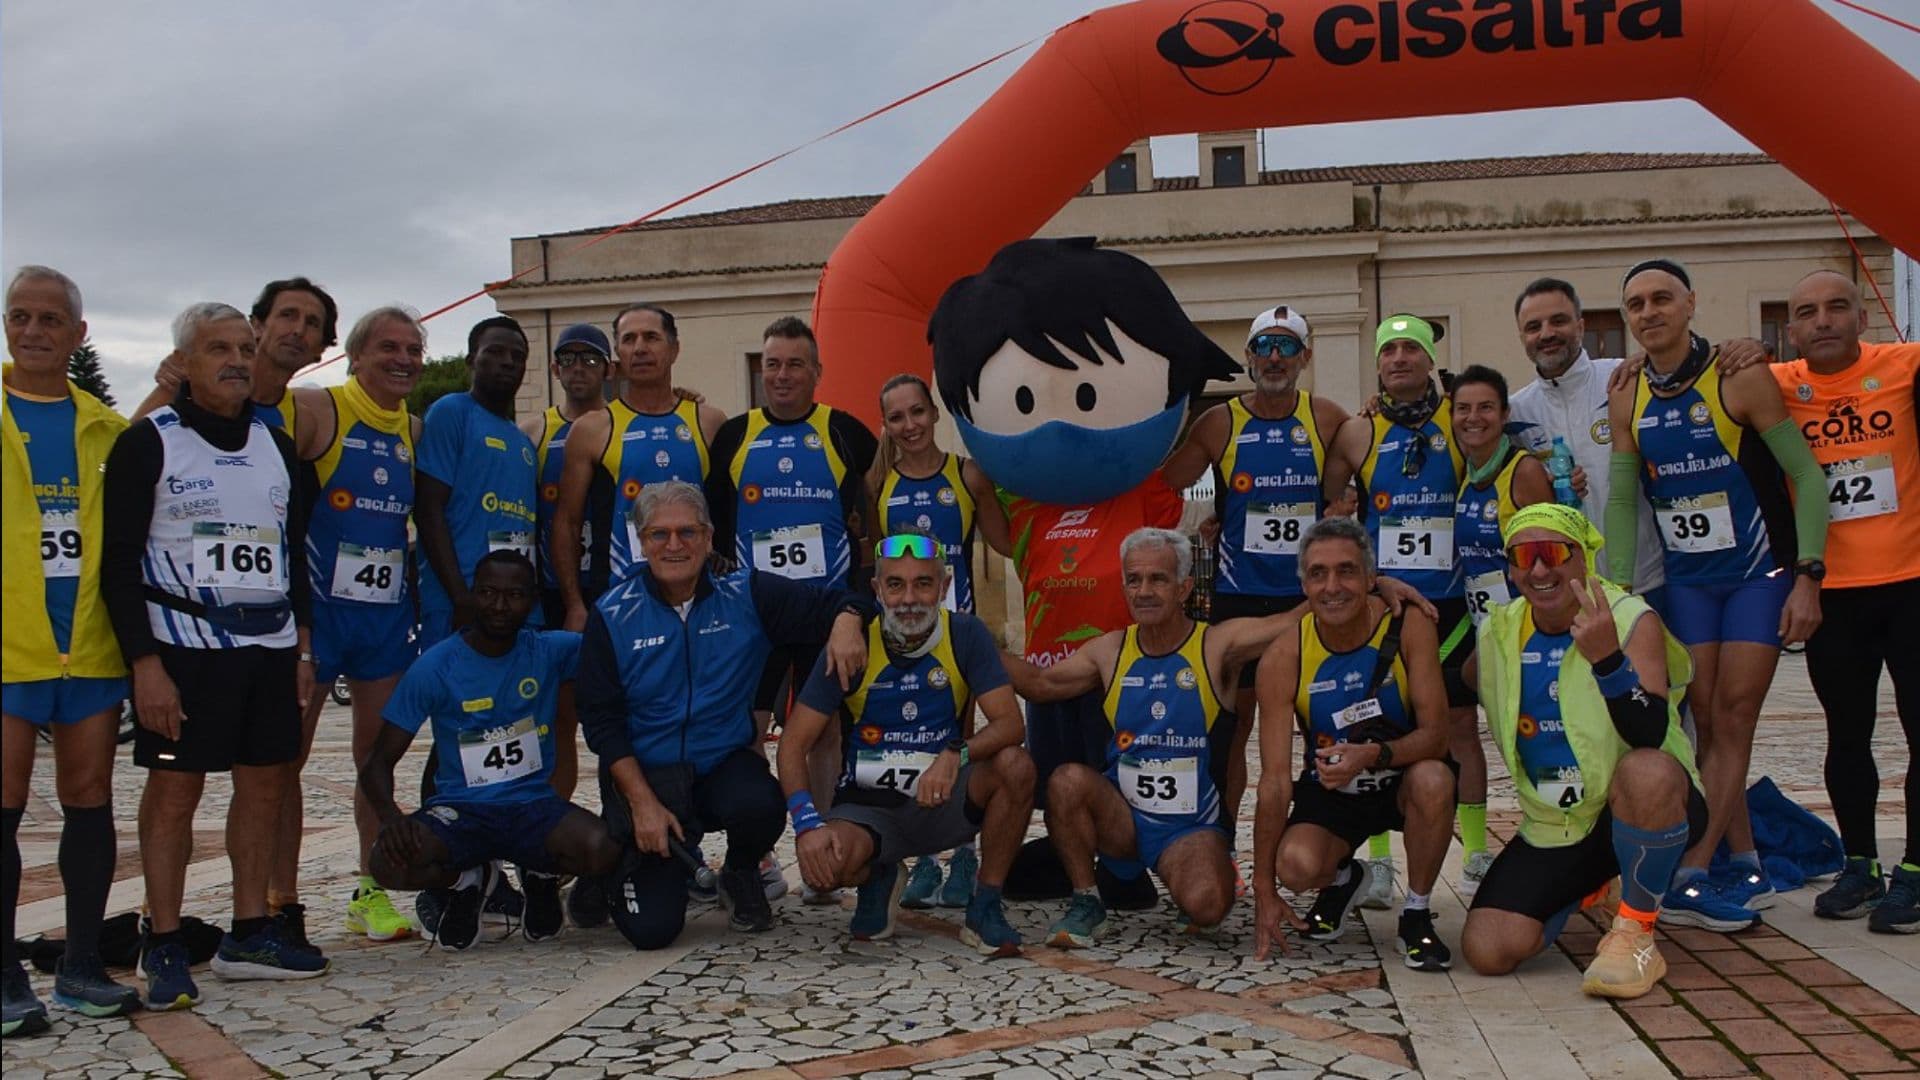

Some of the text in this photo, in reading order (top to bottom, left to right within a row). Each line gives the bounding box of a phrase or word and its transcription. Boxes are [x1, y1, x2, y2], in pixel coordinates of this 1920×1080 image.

[1313, 0, 1684, 66] cisalfa
[1802, 410, 1893, 441] CORO
[1809, 430, 1895, 449] ALF MARATHON
[1657, 452, 1731, 476] GUGLIELMO
[763, 481, 834, 500] GUGLIELMO
[1255, 468, 1317, 488] GUGLIELM
[1829, 476, 1876, 506] 42
[1264, 519, 1300, 542] 38
[1672, 513, 1711, 541] 39
[42, 529, 82, 561] 59
[770, 543, 807, 568] 56
[1397, 533, 1432, 557] 51
[207, 543, 273, 574] 166
[354, 564, 392, 589] 48
[483, 740, 524, 769] 45
[876, 769, 920, 790] 47
[1136, 775, 1178, 800] 53
[1558, 786, 1585, 808] 4
